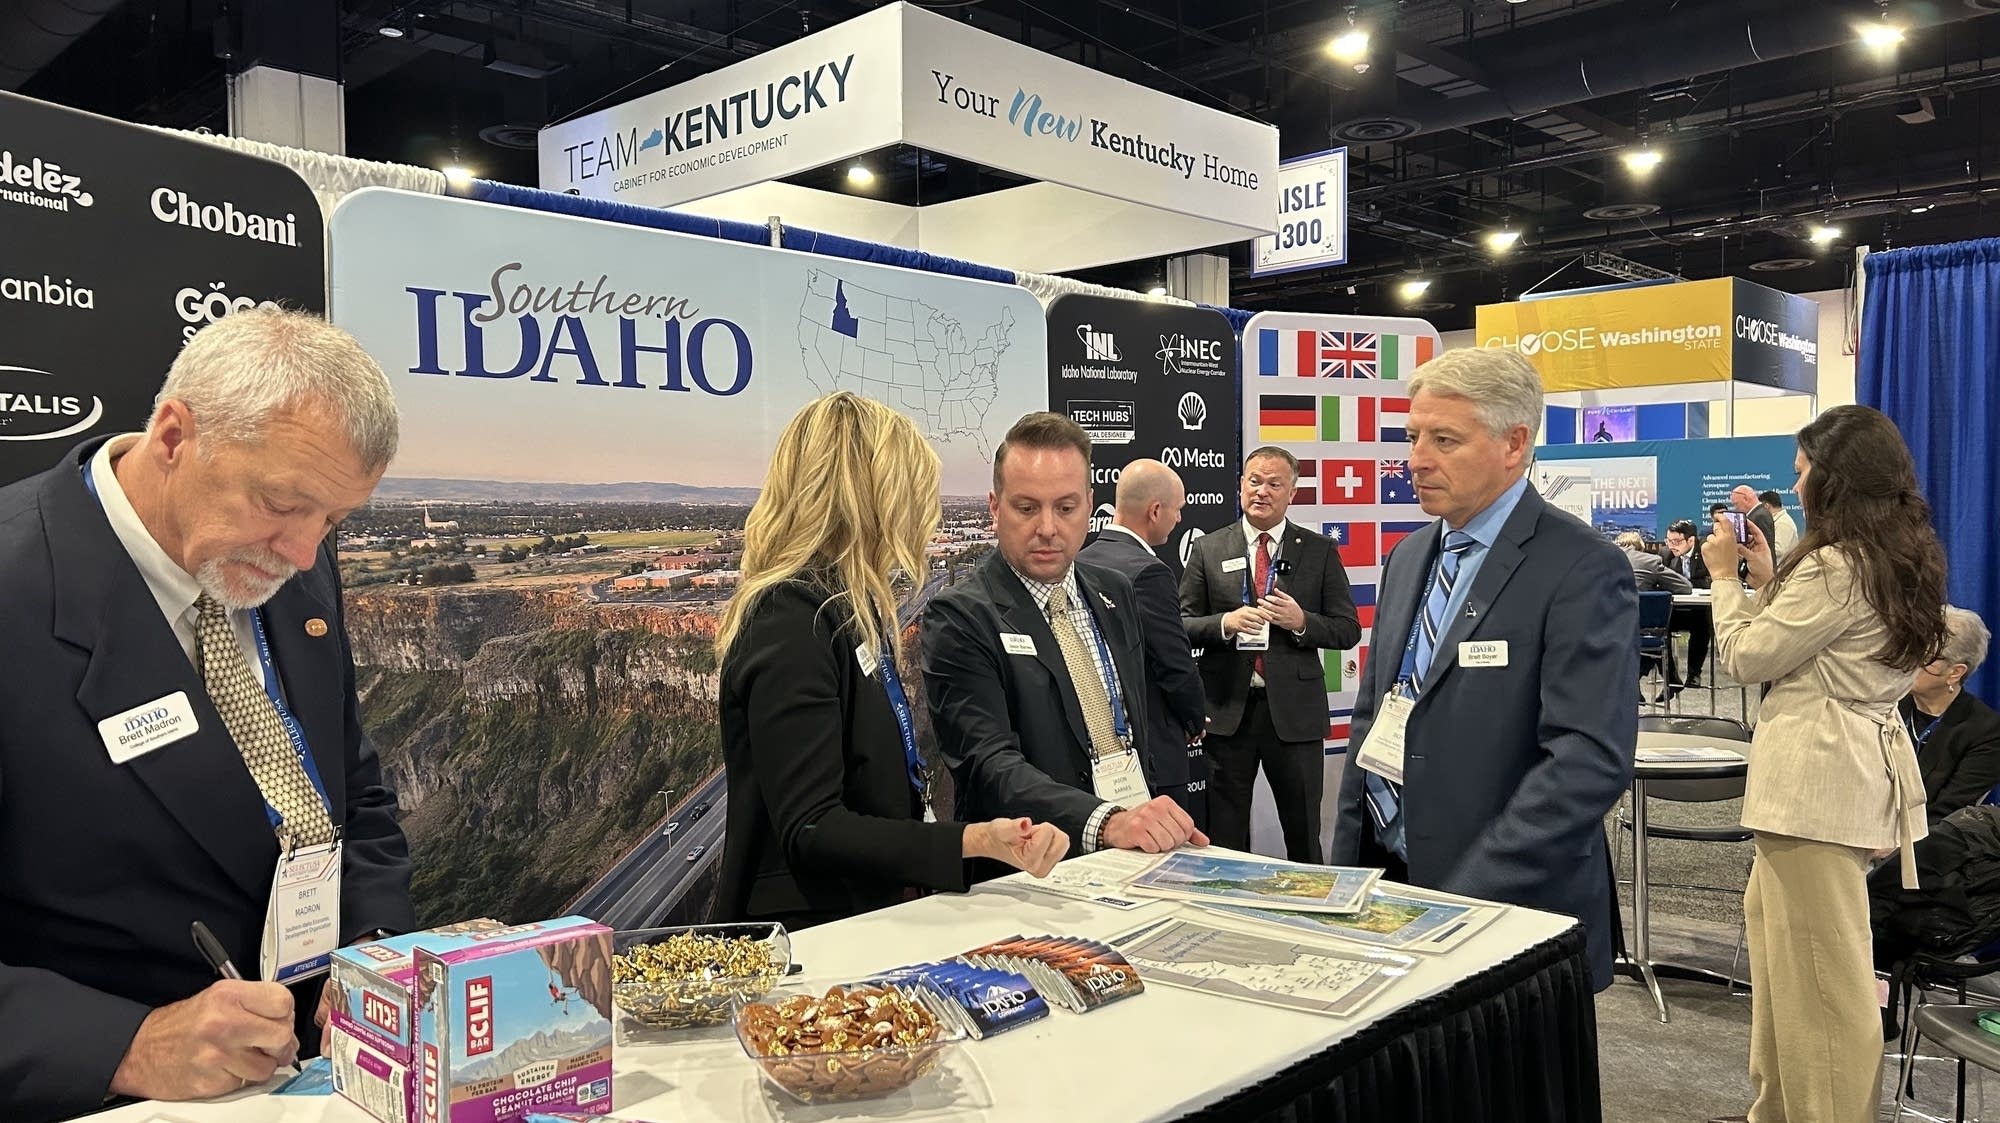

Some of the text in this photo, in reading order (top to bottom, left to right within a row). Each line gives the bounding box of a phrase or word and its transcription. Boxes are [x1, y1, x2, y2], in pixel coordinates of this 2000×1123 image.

[564, 54, 855, 183] TEAM KENTUCKY
[932, 70, 1258, 190] Your New Kentucky Home
[613, 133, 788, 193] CABINET FOR ECONOMIC DEVELOPMENT
[150, 187, 297, 247] Chobani
[0, 275, 94, 309] anbia
[475, 262, 699, 322] Southern
[405, 286, 754, 397] IDAHO
[1599, 323, 1721, 348] Washington
[1684, 338, 1721, 350] STATE
[1735, 314, 1817, 355] CHOOSE Washington
[1061, 364, 1137, 384] Idaho National Laboratory
[1074, 410, 1129, 422] TECH HUBS
[1184, 448, 1226, 468] Meta
[1594, 476, 1647, 489] THE NEXT
[1186, 492, 1224, 504] orano
[1591, 490, 1649, 509] THING
[1470, 645, 1496, 653] IDAHO
[119, 715, 181, 745] Brett Madron
[124, 708, 168, 731] IDAHO
[274, 698, 304, 750] SELECTUSA
[898, 708, 912, 751] SELECTUSA
[298, 887, 317, 899] BRETT
[295, 903, 321, 916] MADRON
[293, 960, 318, 973] ATTENDEE
[1085, 969, 1126, 993] IDAHO
[366, 997, 392, 1030] CLIF
[469, 983, 490, 1037] CLIF
[980, 990, 1027, 1018] IDAHO
[470, 1036, 490, 1049] BAR
[570, 1051, 599, 1063] MADE WITH
[424, 1048, 437, 1116] CLIF
[517, 1064, 555, 1080] SUSTAINED
[521, 1072, 551, 1086] ENERGY
[471, 1086, 497, 1097] PER BAR
[478, 1079, 504, 1089] PROTEIN
[492, 1082, 553, 1107] CHOCOLATE
[555, 1076, 577, 1091] CHIP
[535, 1086, 575, 1104] CRUNCH
